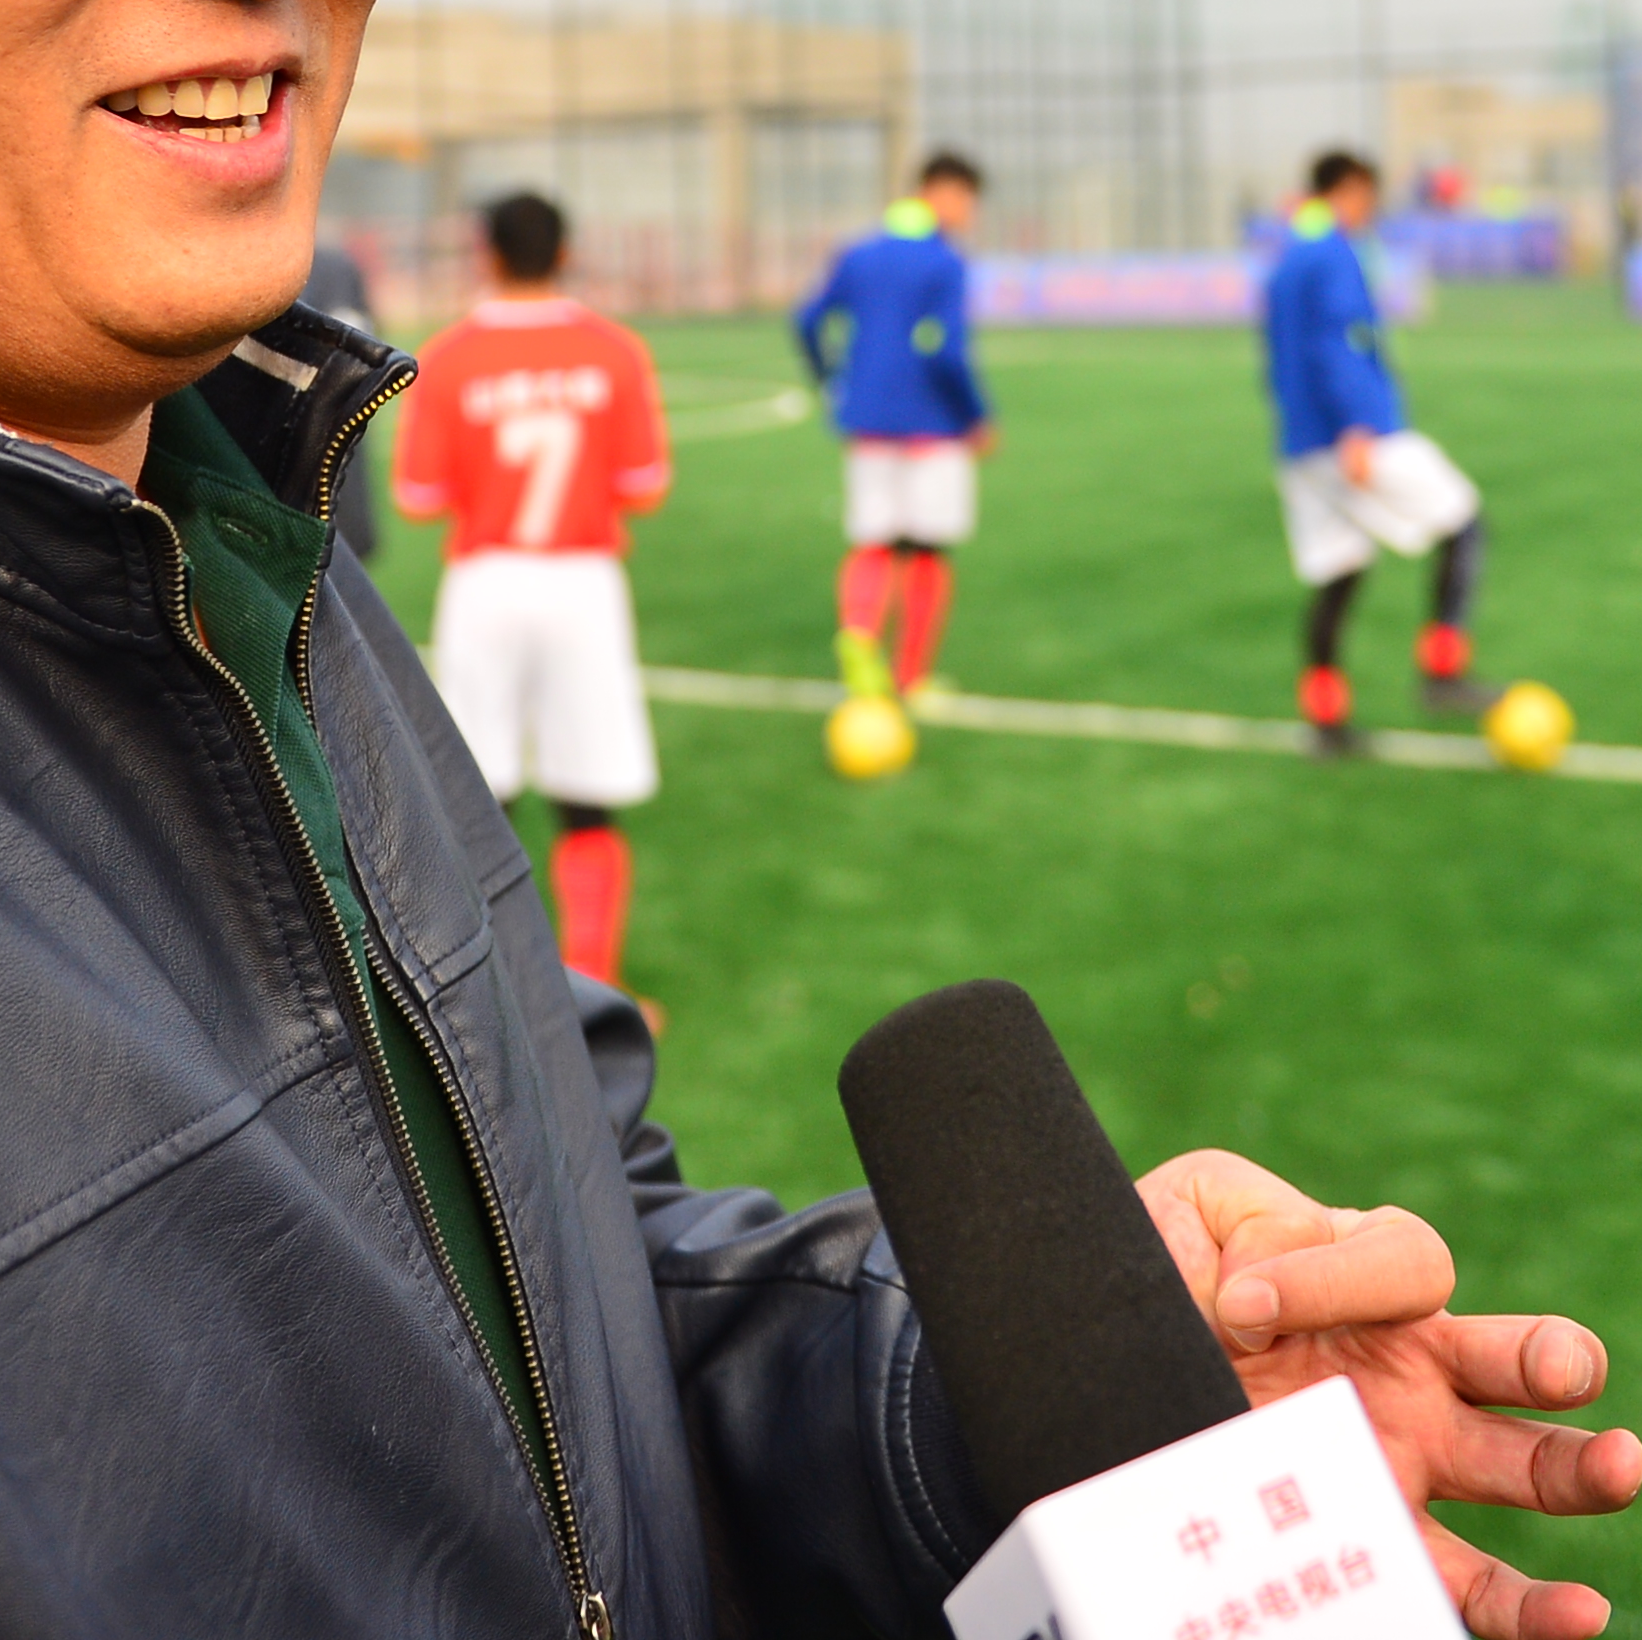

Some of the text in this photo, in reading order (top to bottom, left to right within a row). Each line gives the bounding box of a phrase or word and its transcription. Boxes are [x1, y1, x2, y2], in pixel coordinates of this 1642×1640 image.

[494, 412, 582, 548] 7
[1177, 1472, 1311, 1566] 中国
[1174, 1544, 1375, 1640] 中央电视台
